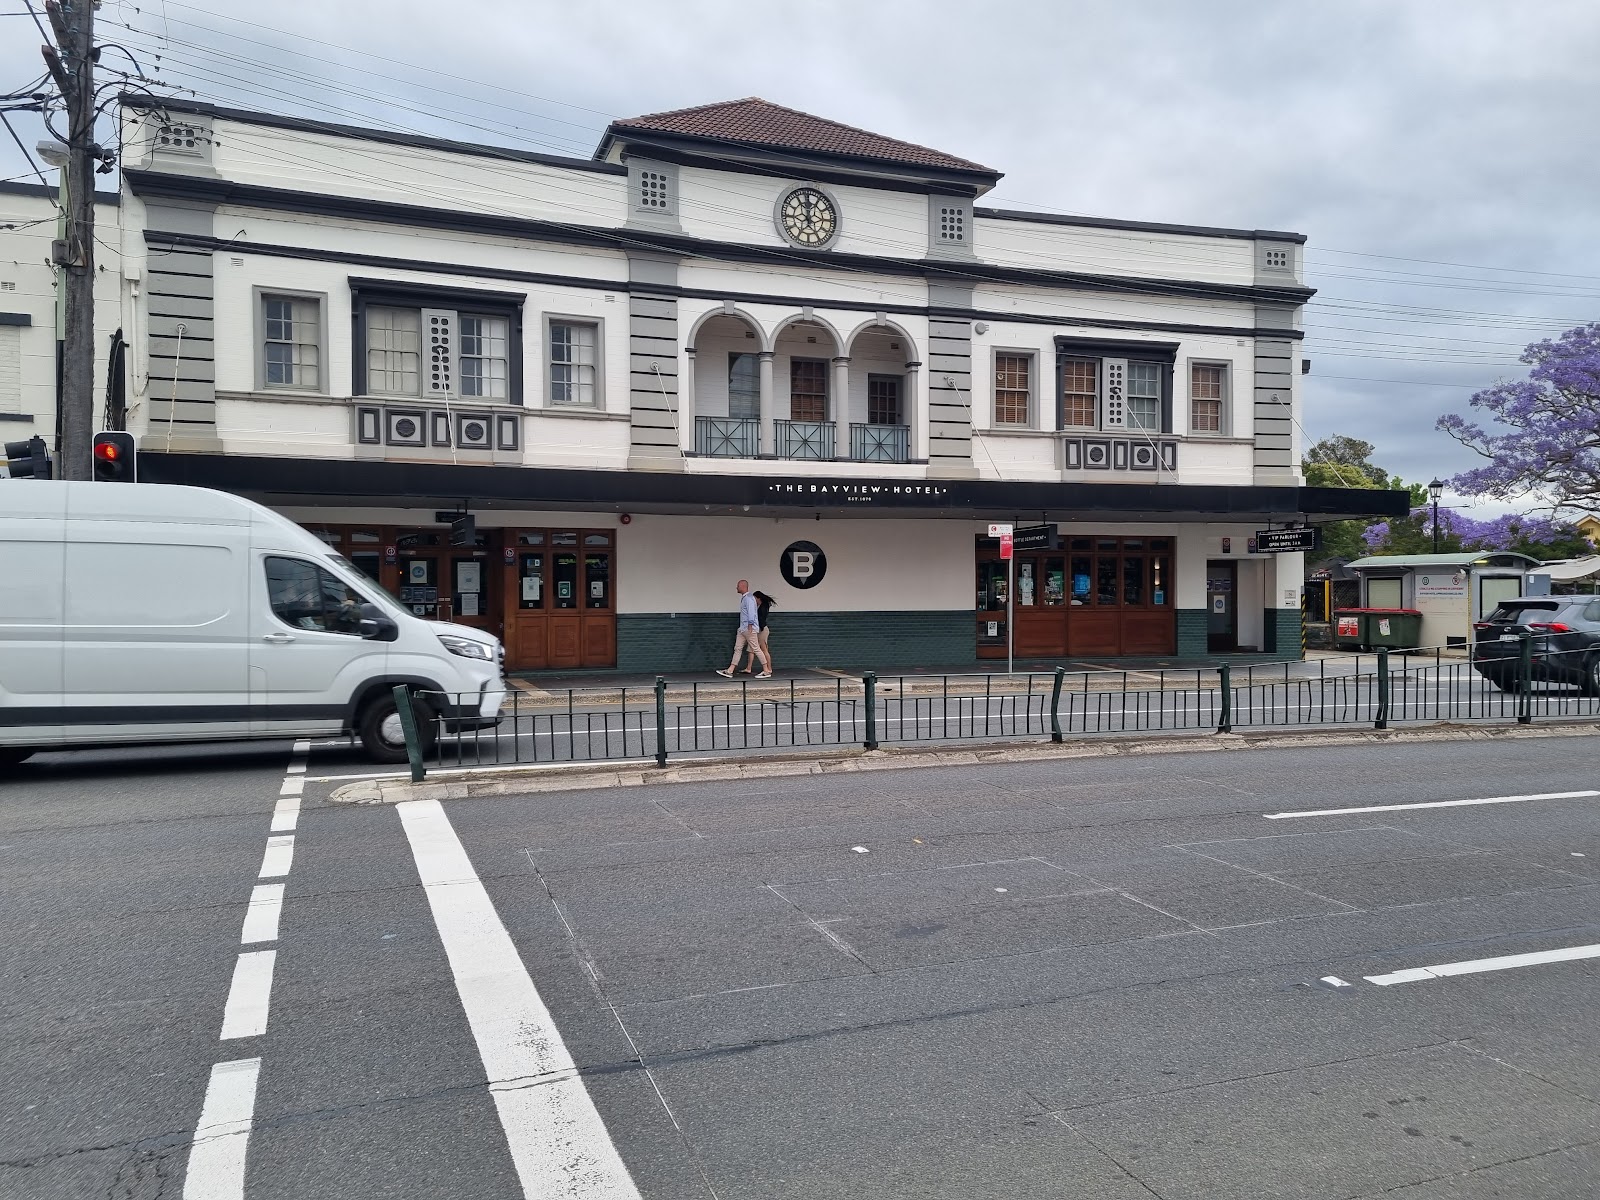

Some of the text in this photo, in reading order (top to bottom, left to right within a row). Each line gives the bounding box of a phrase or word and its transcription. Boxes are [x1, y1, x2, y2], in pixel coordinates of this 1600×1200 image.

[775, 484, 940, 494] THE BAYVIEW HOTEL
[793, 551, 814, 578] B
